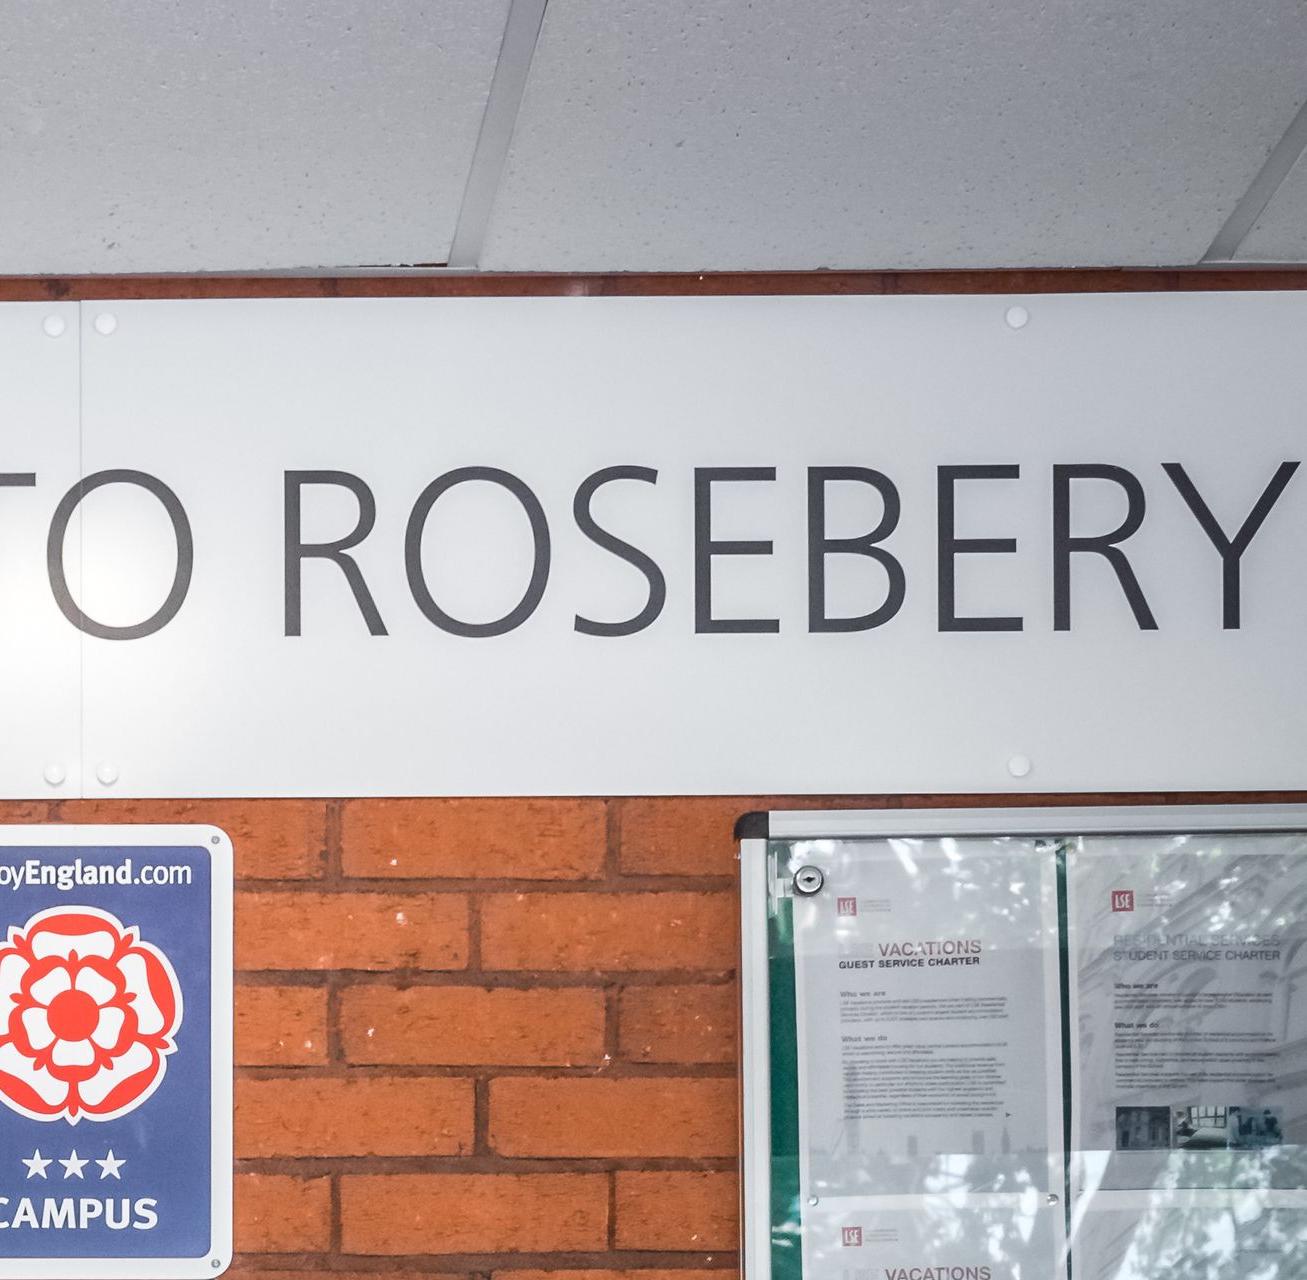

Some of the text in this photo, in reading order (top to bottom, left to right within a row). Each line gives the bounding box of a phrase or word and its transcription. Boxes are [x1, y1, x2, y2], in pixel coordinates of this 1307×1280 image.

[284, 461, 1301, 638] ROSEBERY
[837, 898, 857, 916] LSE
[1113, 891, 1133, 911] LSE
[878, 940, 982, 957] VACATIONS
[1113, 950, 1281, 961] SUDENT SERVICE CHARTER
[839, 956, 980, 970] GUEST SERVICE CHARTER
[842, 1227, 863, 1246] LSE
